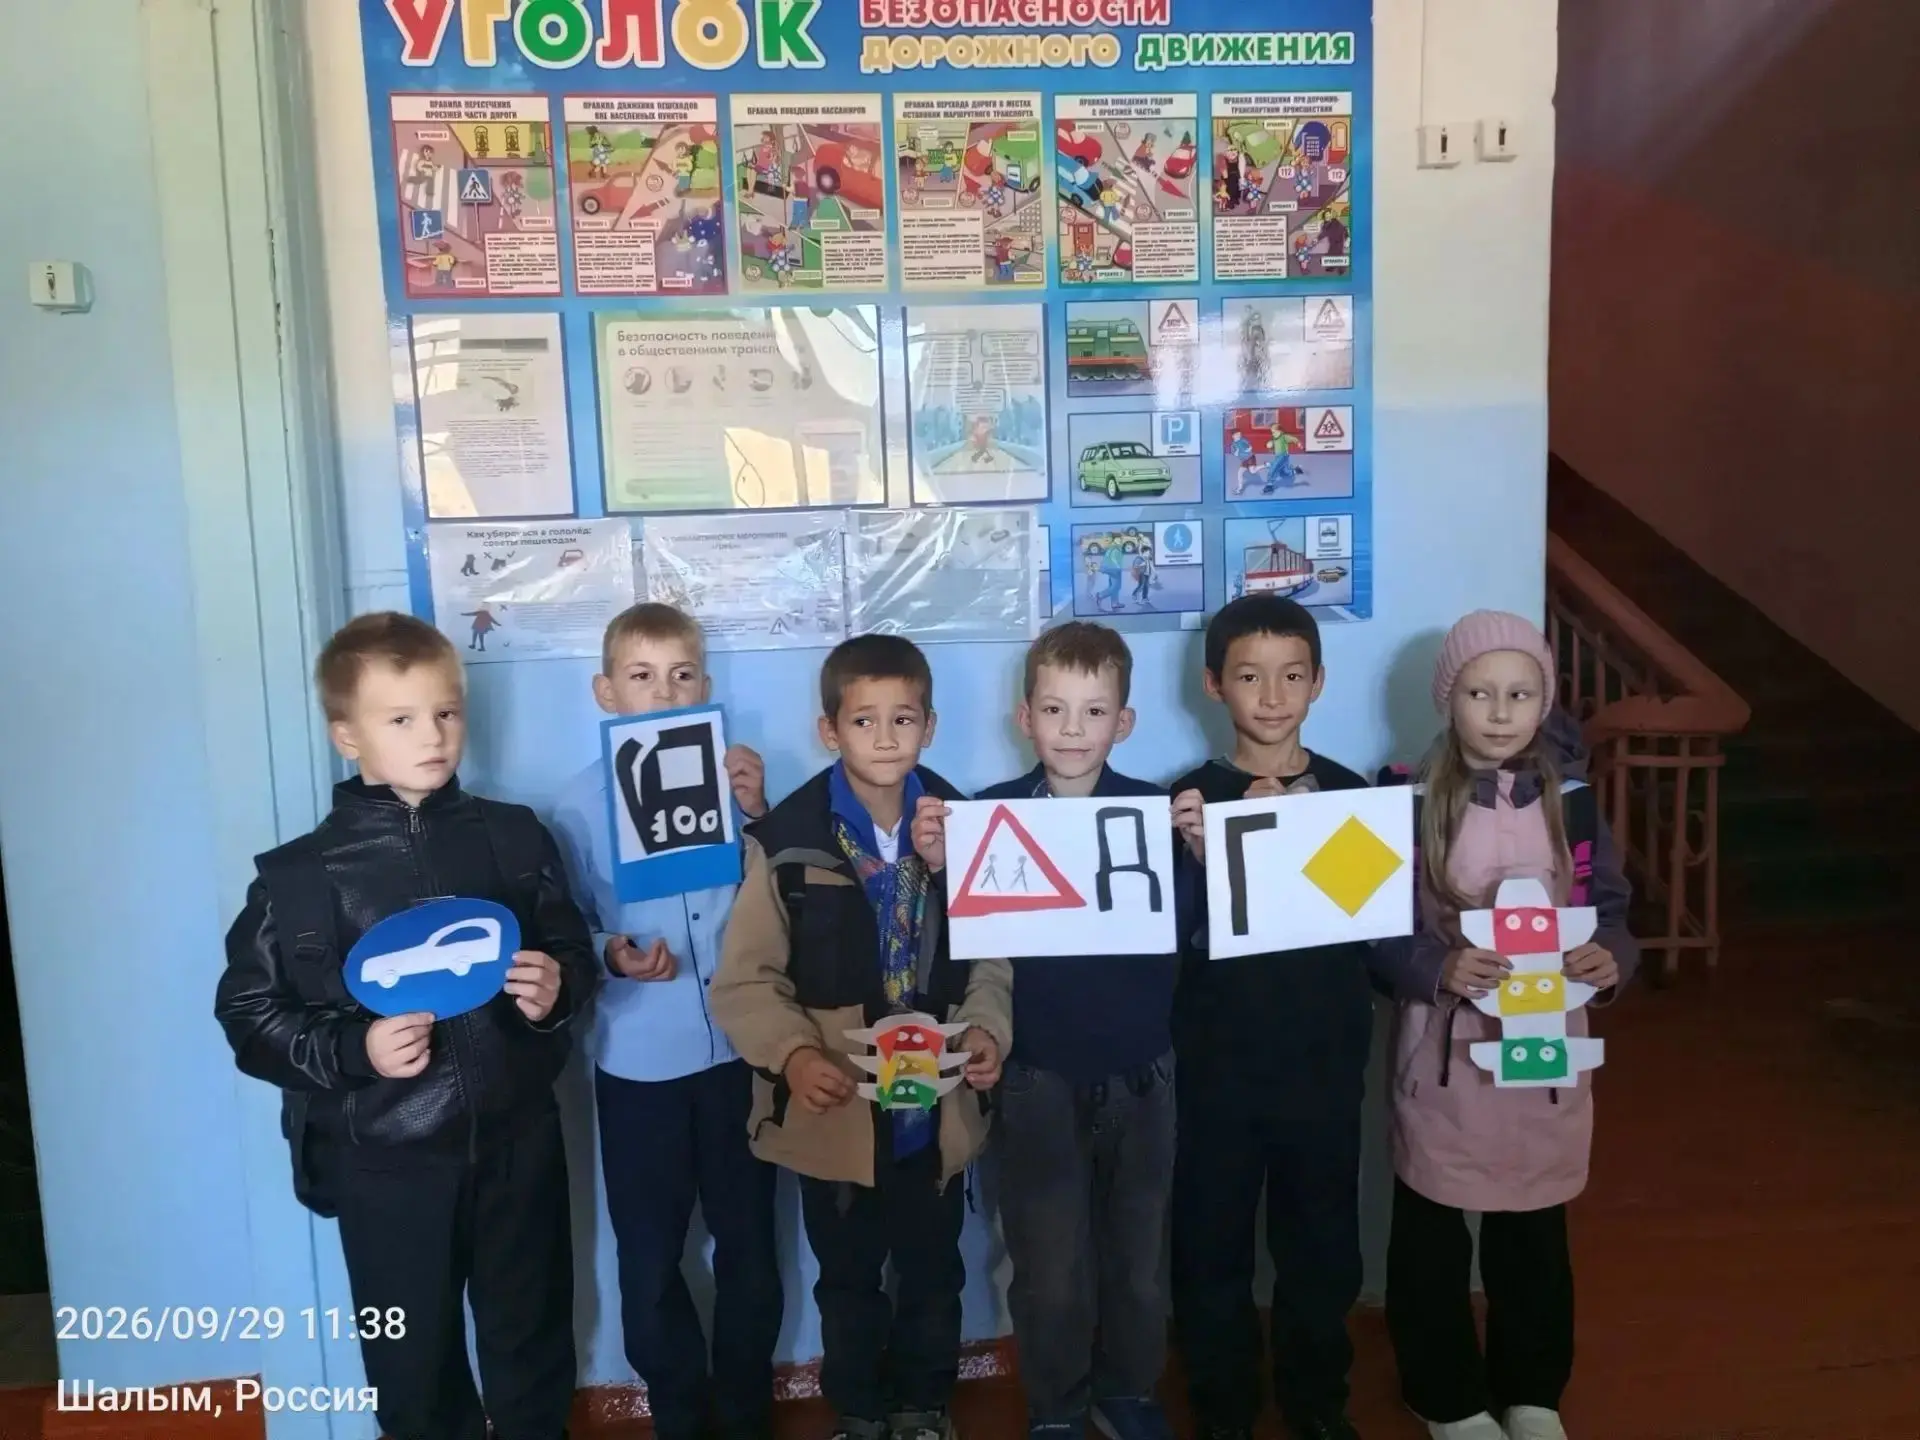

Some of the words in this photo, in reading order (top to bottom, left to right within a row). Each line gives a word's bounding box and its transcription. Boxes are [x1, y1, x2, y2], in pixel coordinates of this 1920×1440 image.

[861, 0, 1171, 27] БЕЗОПАСНОСТИ
[383, 0, 826, 70] УГОЛОК
[860, 35, 1121, 72] ДОРОЖНОГО
[1135, 32, 1355, 71] ДВИЖЕНИЯ
[618, 330, 708, 342] Безопасность
[618, 348, 625, 356] в
[629, 345, 727, 357] общественном
[1168, 416, 1184, 442] P
